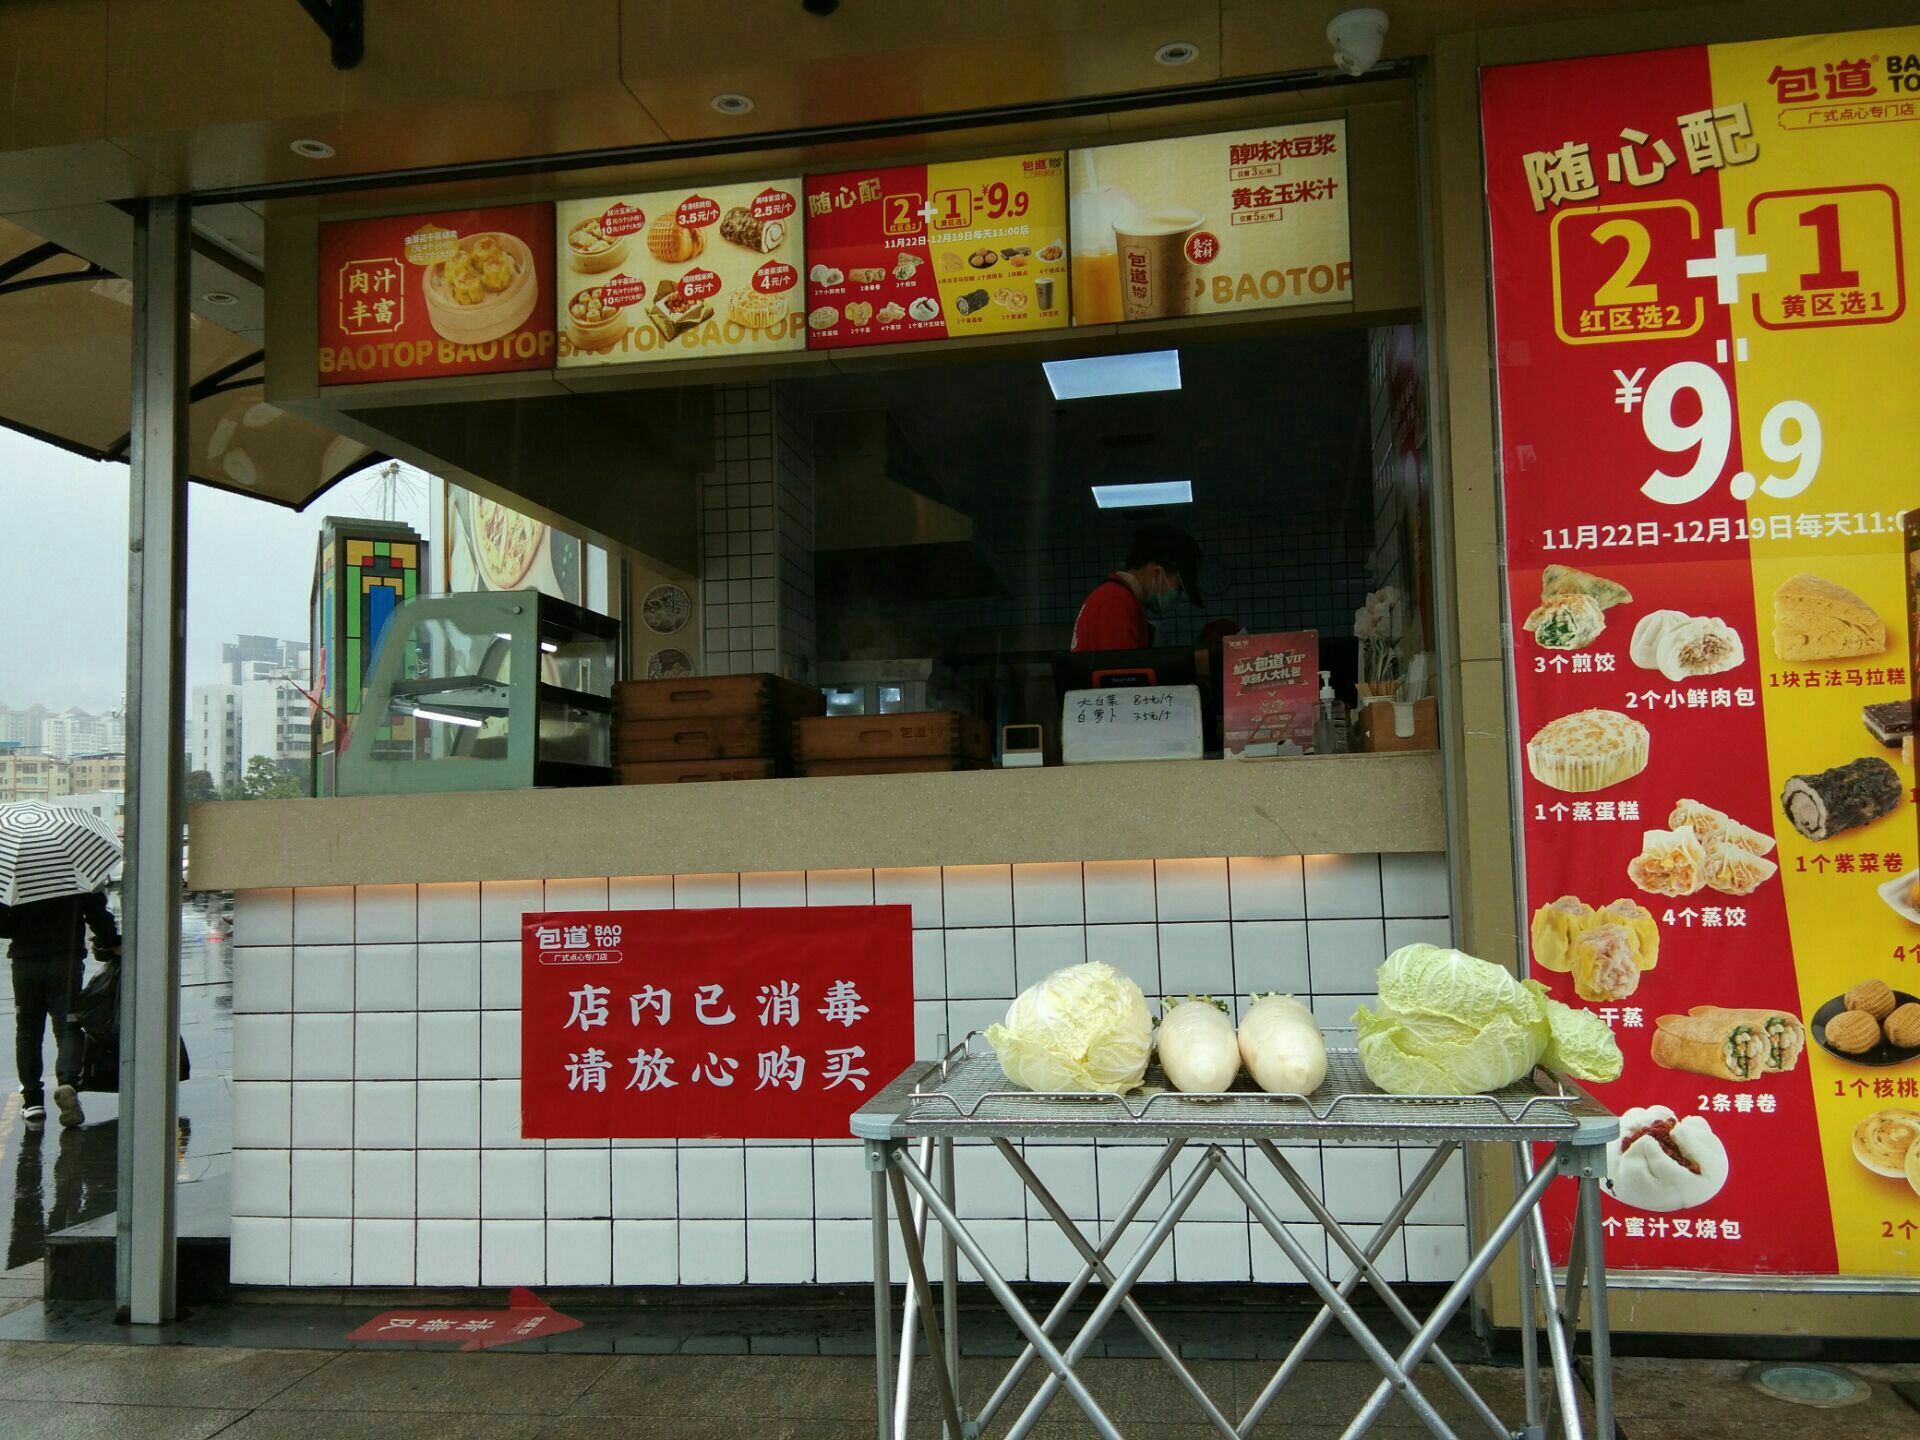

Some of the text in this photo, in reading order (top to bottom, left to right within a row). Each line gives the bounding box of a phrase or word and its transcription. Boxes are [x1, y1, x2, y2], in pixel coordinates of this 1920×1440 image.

[1767, 58, 1877, 104] 包道
[1808, 103, 1914, 124] 广式点心专门店
[1229, 133, 1337, 166] 醇味浓豆浆
[1522, 102, 1760, 213] 随心配
[808, 177, 883, 218] 随心配
[1231, 177, 1338, 211] 黄金玉米汁
[678, 208, 719, 225] 3.5元/个
[754, 202, 793, 218] 2.5元/个
[1128, 252, 1148, 285] 包道
[348, 267, 397, 294] 肉汁
[683, 281, 715, 298] 6元/个
[760, 274, 792, 290] 4元/个
[1212, 261, 1353, 304] BAOTOP
[347, 297, 396, 328] 丰富
[1781, 291, 1886, 320] 黄区选1
[1579, 304, 1682, 334] 红区选2
[319, 340, 433, 373] BAOTOP
[1534, 652, 1616, 675] 3个煎饺
[1769, 667, 1906, 688] 1块古法马拉糕
[1077, 694, 1119, 708] 大白菜
[1625, 686, 1756, 711] 2个小鲜肉包
[1534, 800, 1641, 822] 1个蒸蛋糕
[1795, 852, 1904, 875] 1个紫菜卷
[1662, 906, 1747, 929] 4个蒸饺
[535, 925, 590, 950] 包道
[594, 924, 622, 937] BAO
[594, 936, 621, 947] TOP
[553, 953, 608, 962] 广式点心专门店
[563, 978, 871, 1031] 店内已消毒
[1592, 1007, 1644, 1028] 干蒸
[564, 1045, 871, 1094] 请放心购买
[1698, 1093, 1777, 1114] 2条春卷
[1881, 1219, 1918, 1239] 2个
